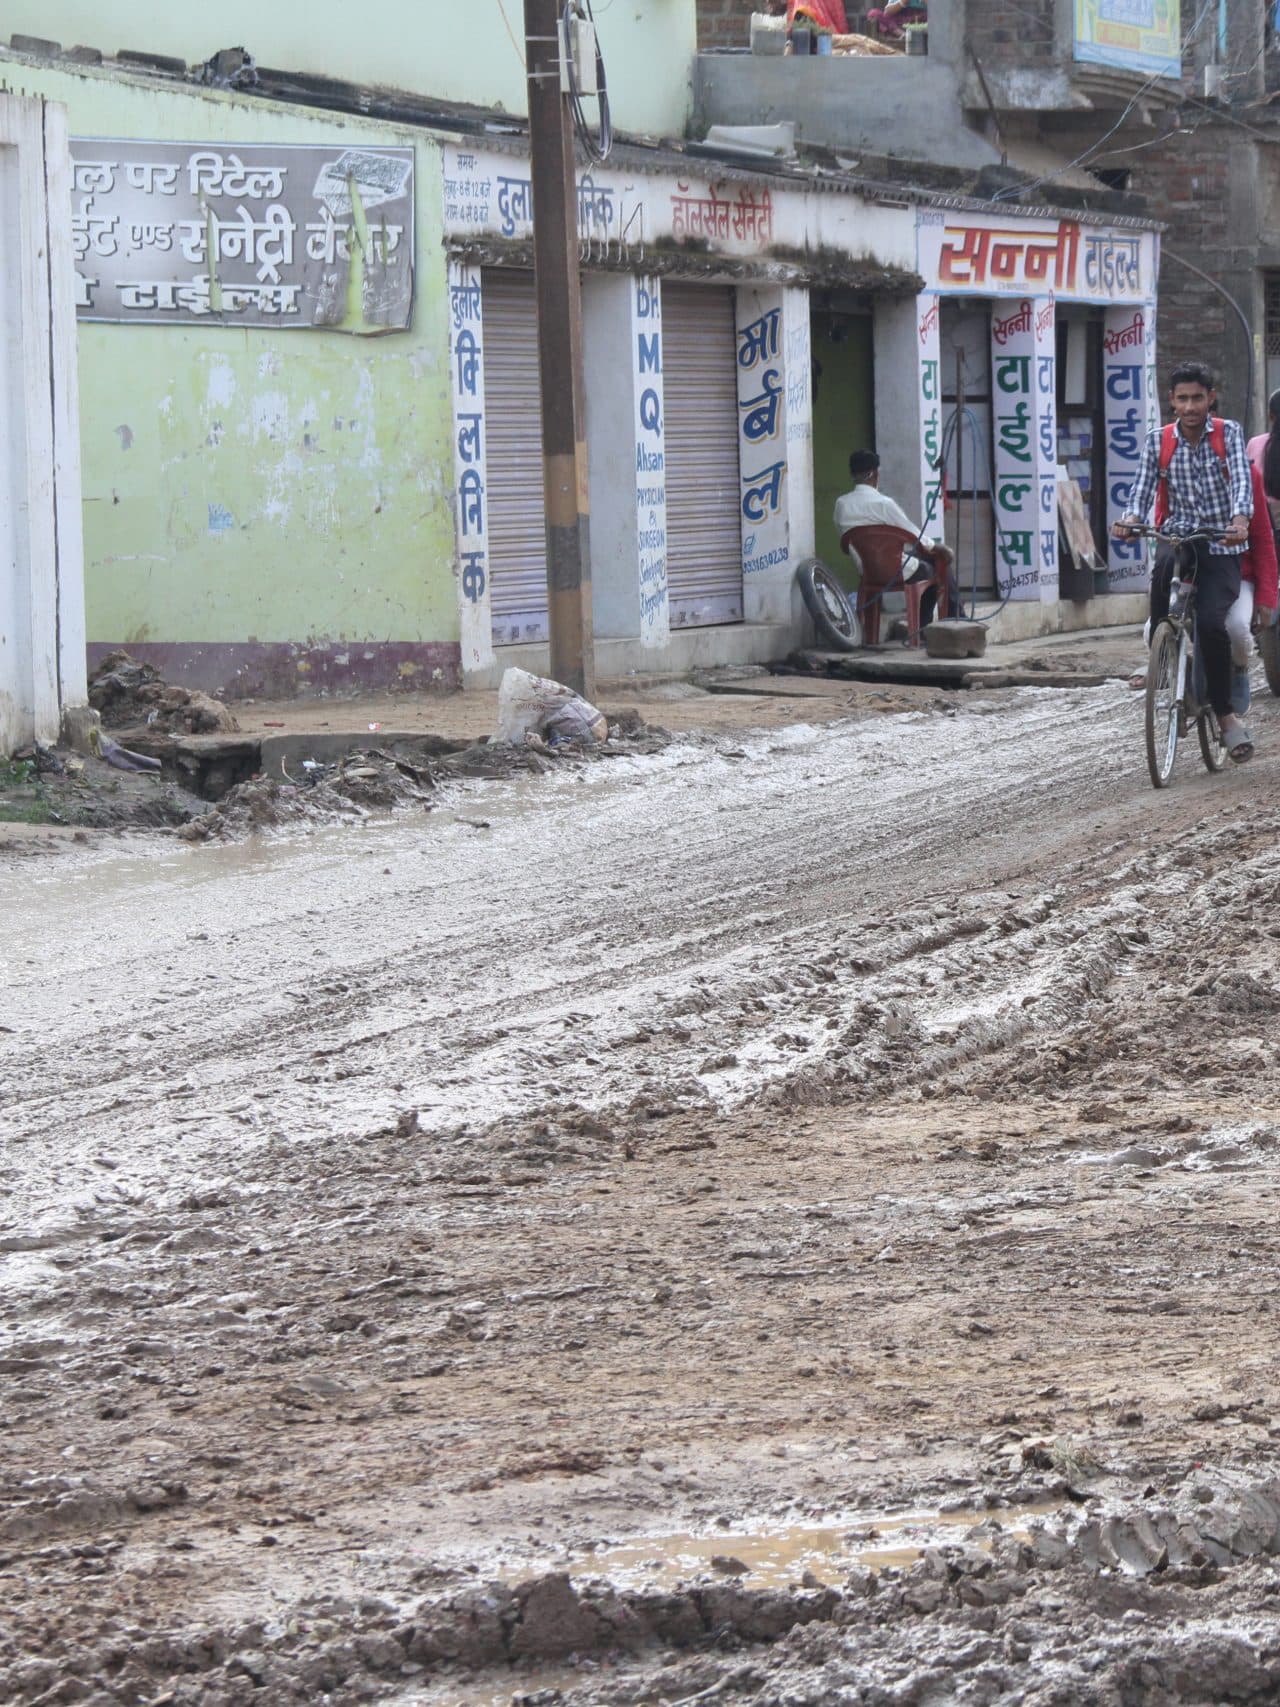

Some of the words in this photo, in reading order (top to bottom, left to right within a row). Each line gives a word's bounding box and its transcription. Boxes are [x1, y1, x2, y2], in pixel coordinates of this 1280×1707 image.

[124, 161, 181, 196] पर
[187, 152, 288, 199] रिटेल
[939, 219, 1081, 290] सन्नी
[637, 290, 660, 318] Dr.
[636, 442, 664, 472] Ahsan
[637, 487, 666, 508] PHYSICIAN
